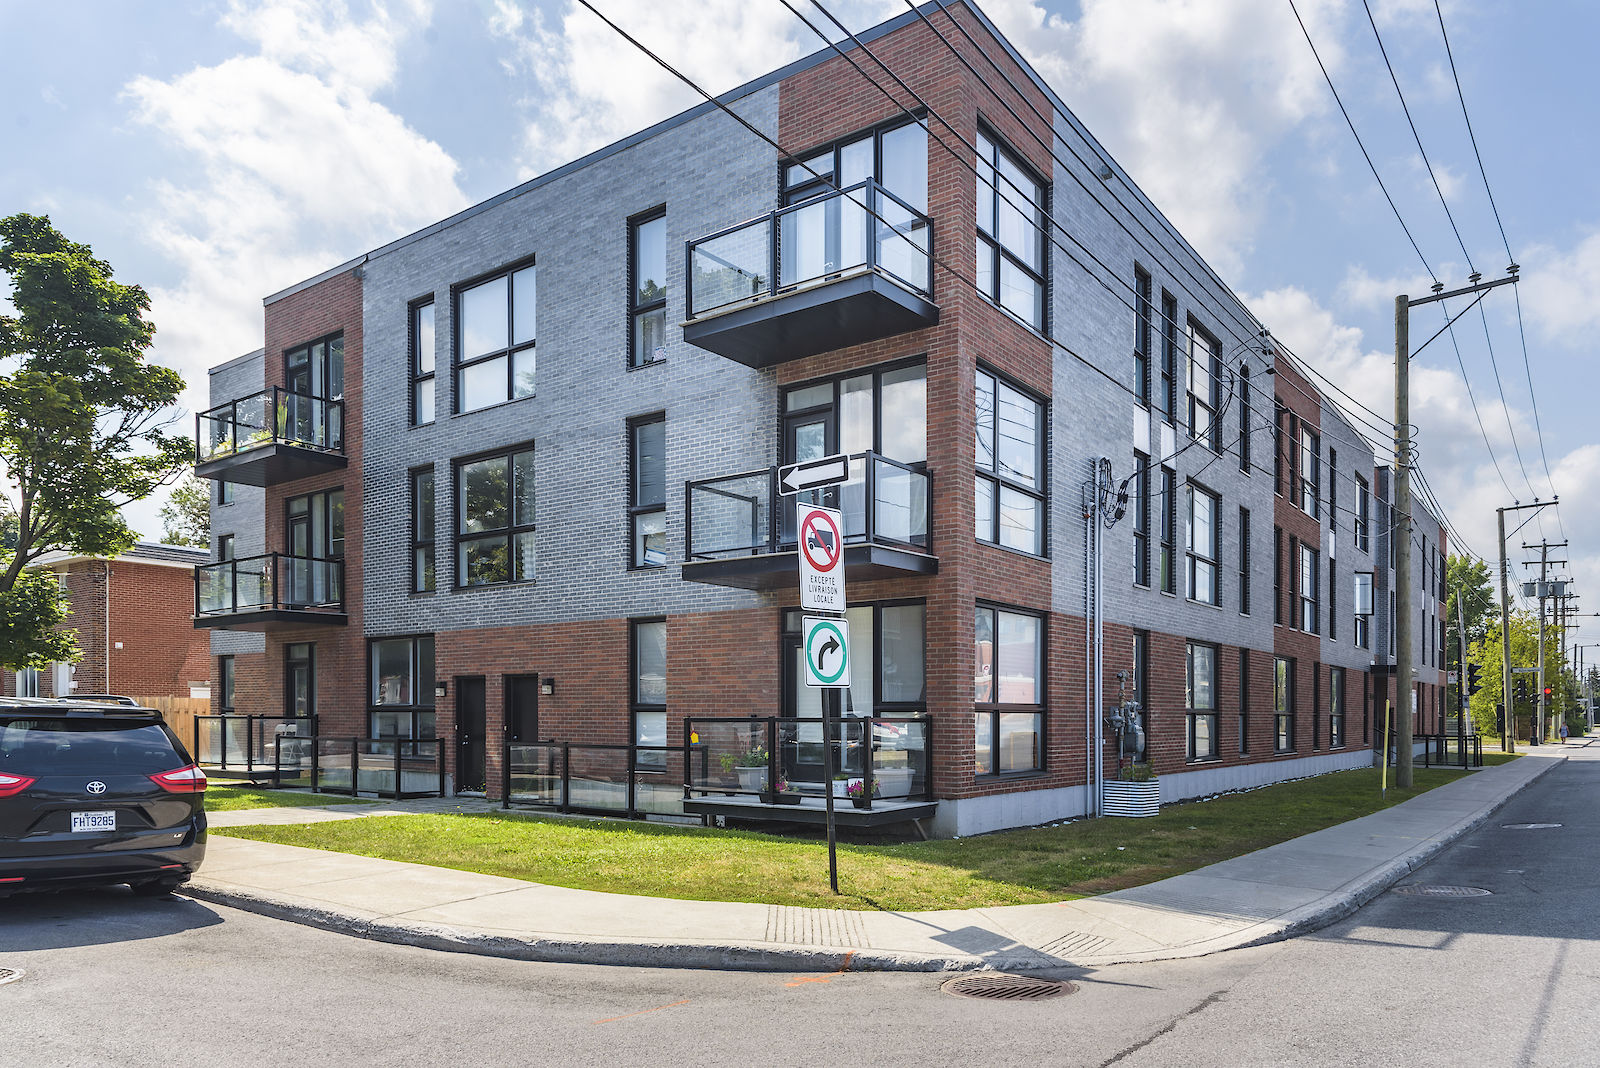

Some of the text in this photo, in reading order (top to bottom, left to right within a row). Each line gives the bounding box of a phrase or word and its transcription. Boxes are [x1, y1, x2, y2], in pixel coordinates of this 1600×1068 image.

[808, 585, 838, 595] LIVRAISON
[813, 594, 834, 604] LOCALE
[73, 815, 114, 827] FHT9285
